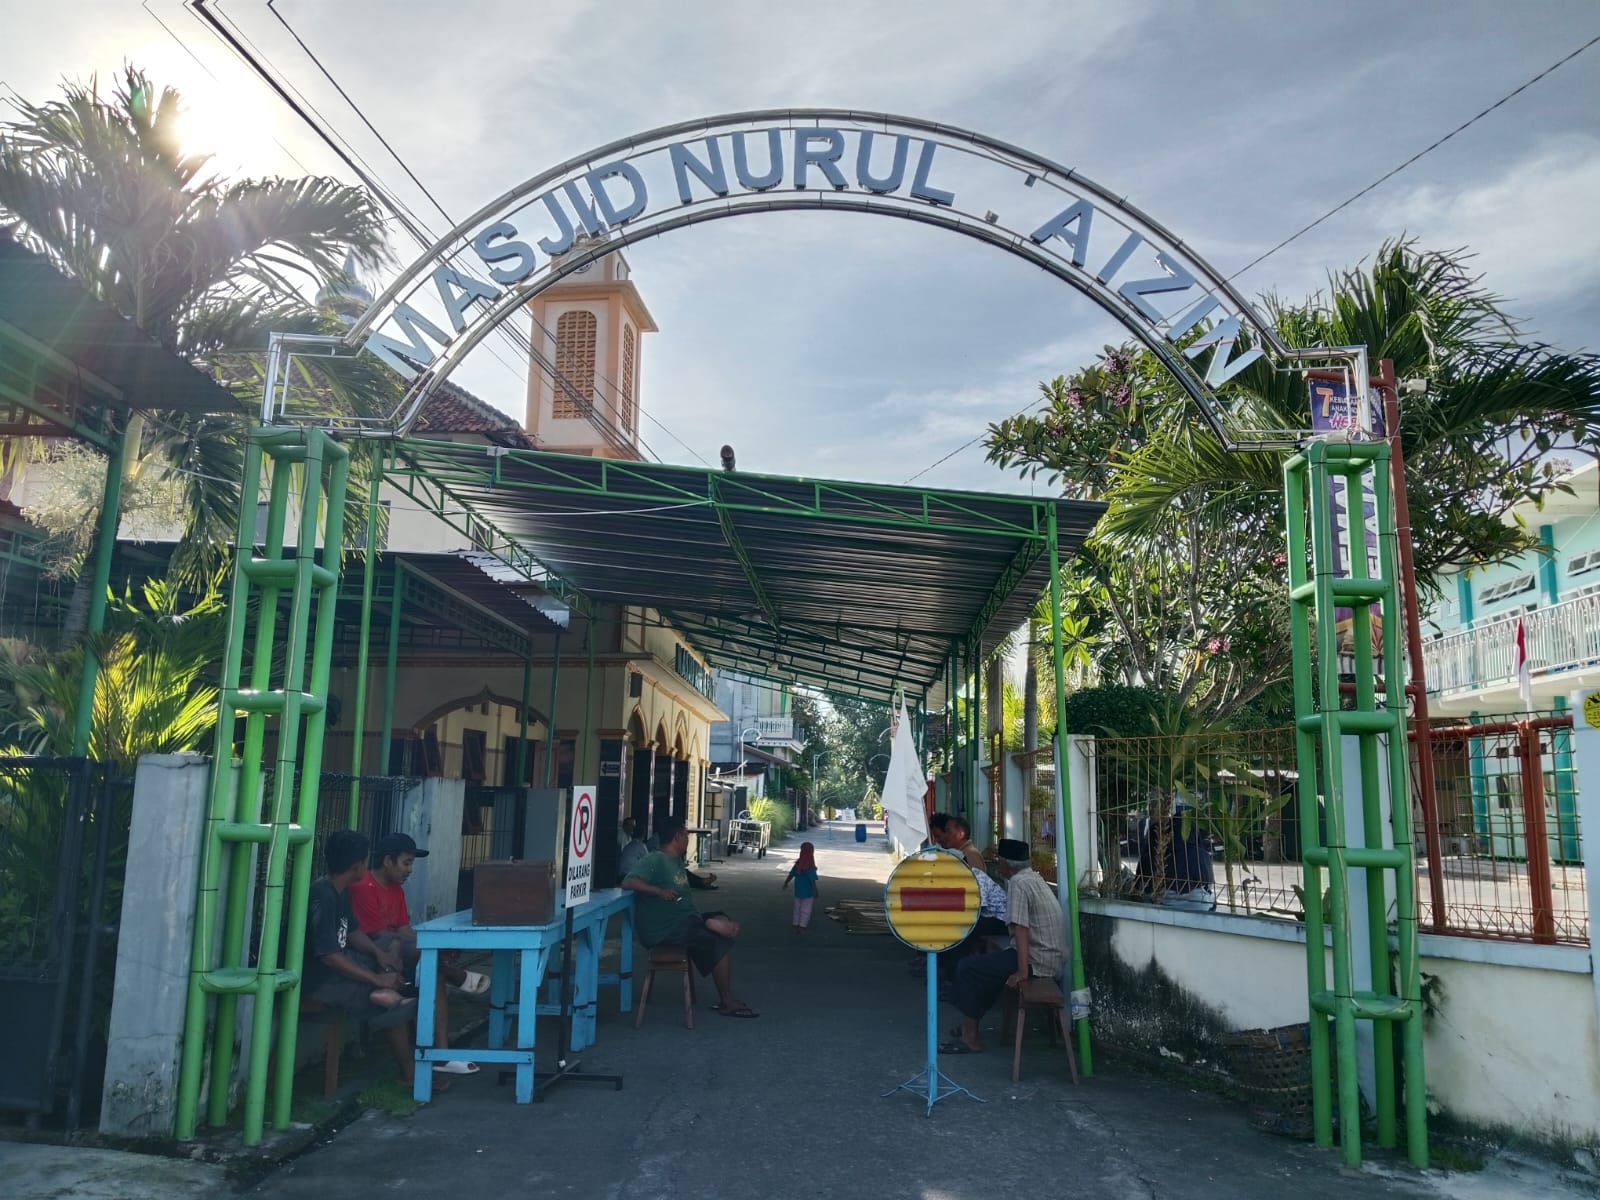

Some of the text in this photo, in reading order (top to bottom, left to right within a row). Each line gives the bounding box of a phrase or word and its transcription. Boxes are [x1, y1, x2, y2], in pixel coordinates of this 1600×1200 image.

[364, 159, 648, 381] MASJID
[669, 127, 955, 206] NURUL
[1316, 387, 1333, 417] 7
[579, 805, 590, 845] P
[568, 863, 590, 882] DILARANG
[570, 882, 587, 900] PARKIR
